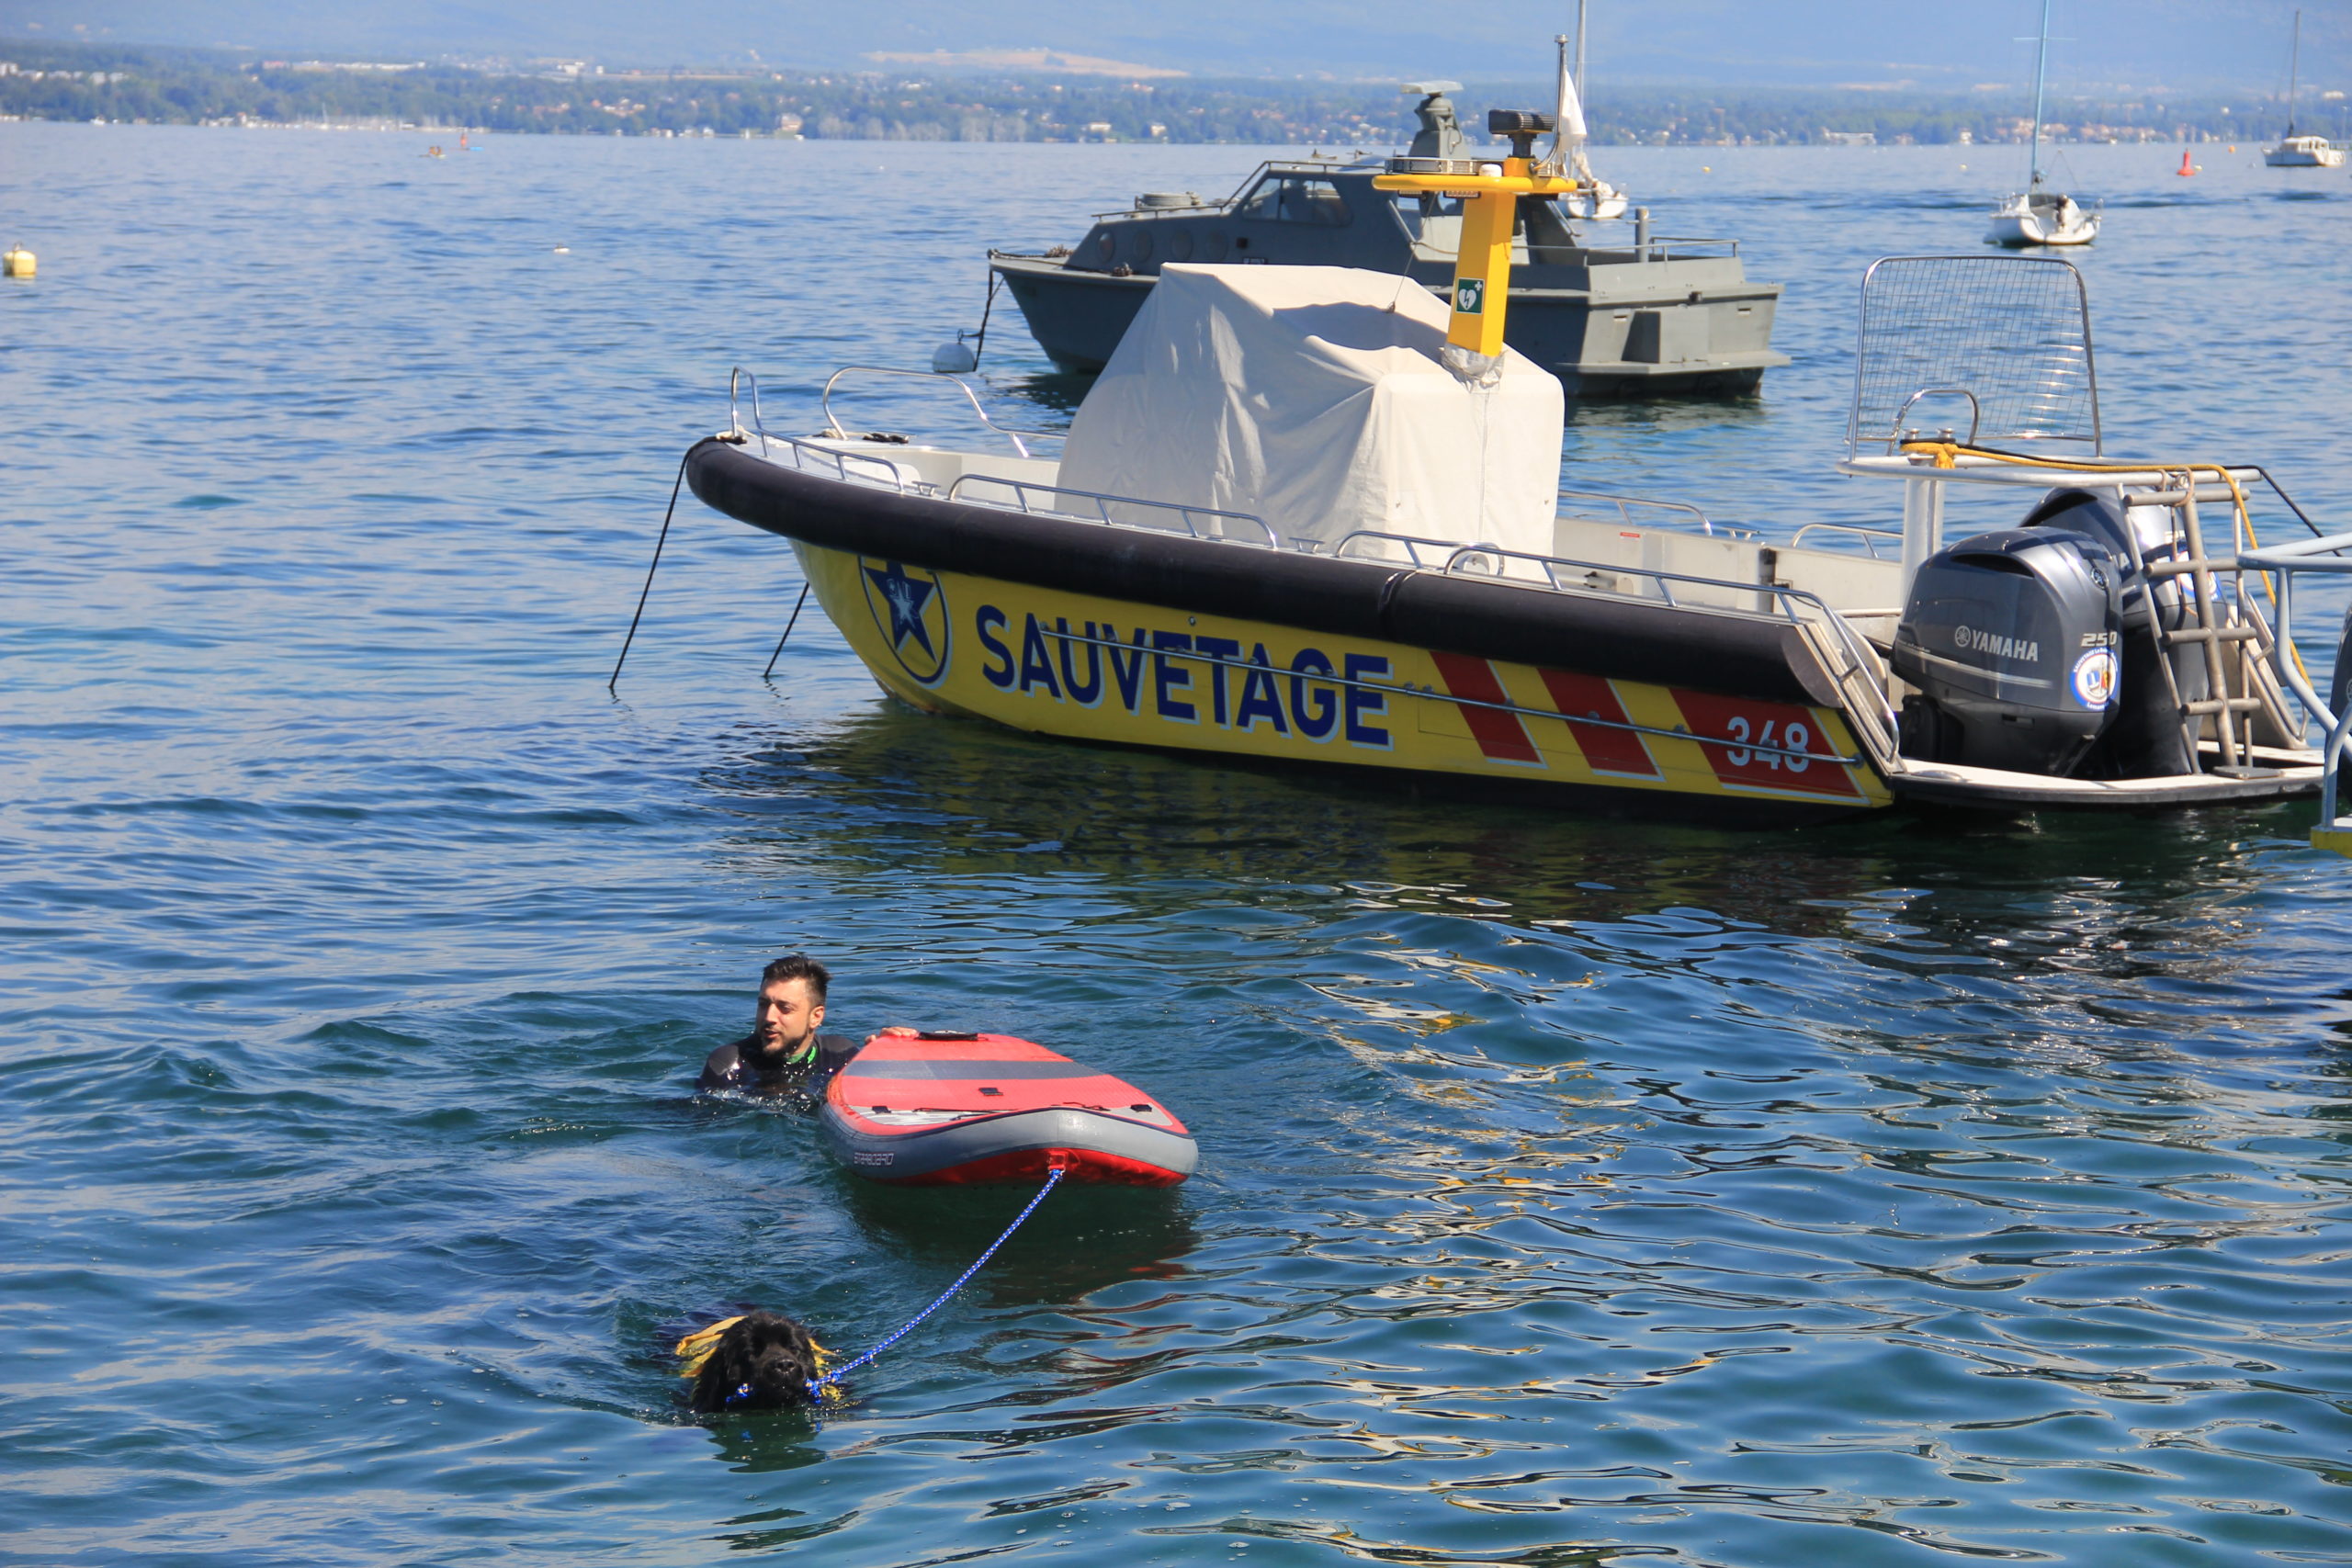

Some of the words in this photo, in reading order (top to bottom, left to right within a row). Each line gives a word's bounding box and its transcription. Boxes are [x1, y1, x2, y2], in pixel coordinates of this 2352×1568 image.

[1972, 630, 2039, 662] YAMAHA
[2081, 631, 2118, 648] 250
[976, 604, 1394, 751] SAUVETAGE
[1726, 716, 1810, 773] 348
